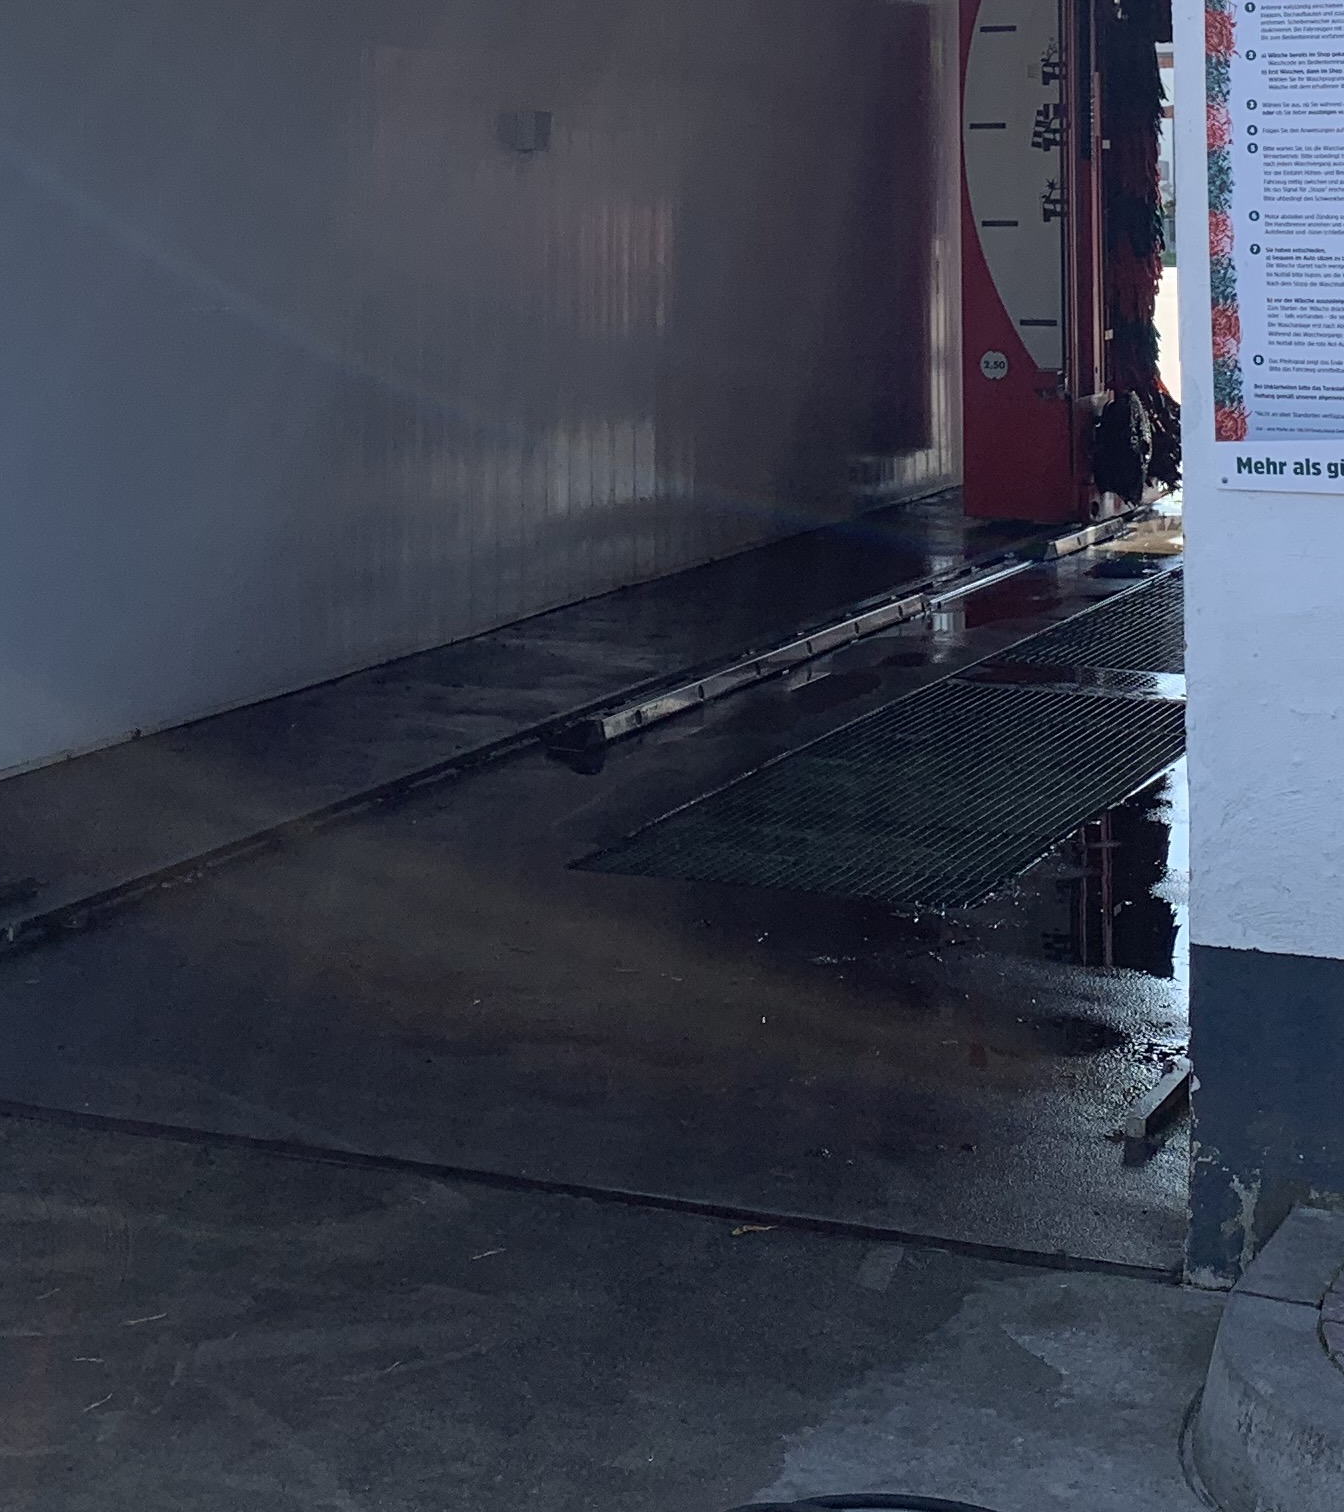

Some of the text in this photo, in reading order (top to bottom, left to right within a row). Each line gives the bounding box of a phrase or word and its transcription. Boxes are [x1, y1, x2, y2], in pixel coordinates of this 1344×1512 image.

[983, 360, 1006, 370] 2.50
[1236, 456, 1287, 476] Mehr
[1292, 458, 1322, 476] als
